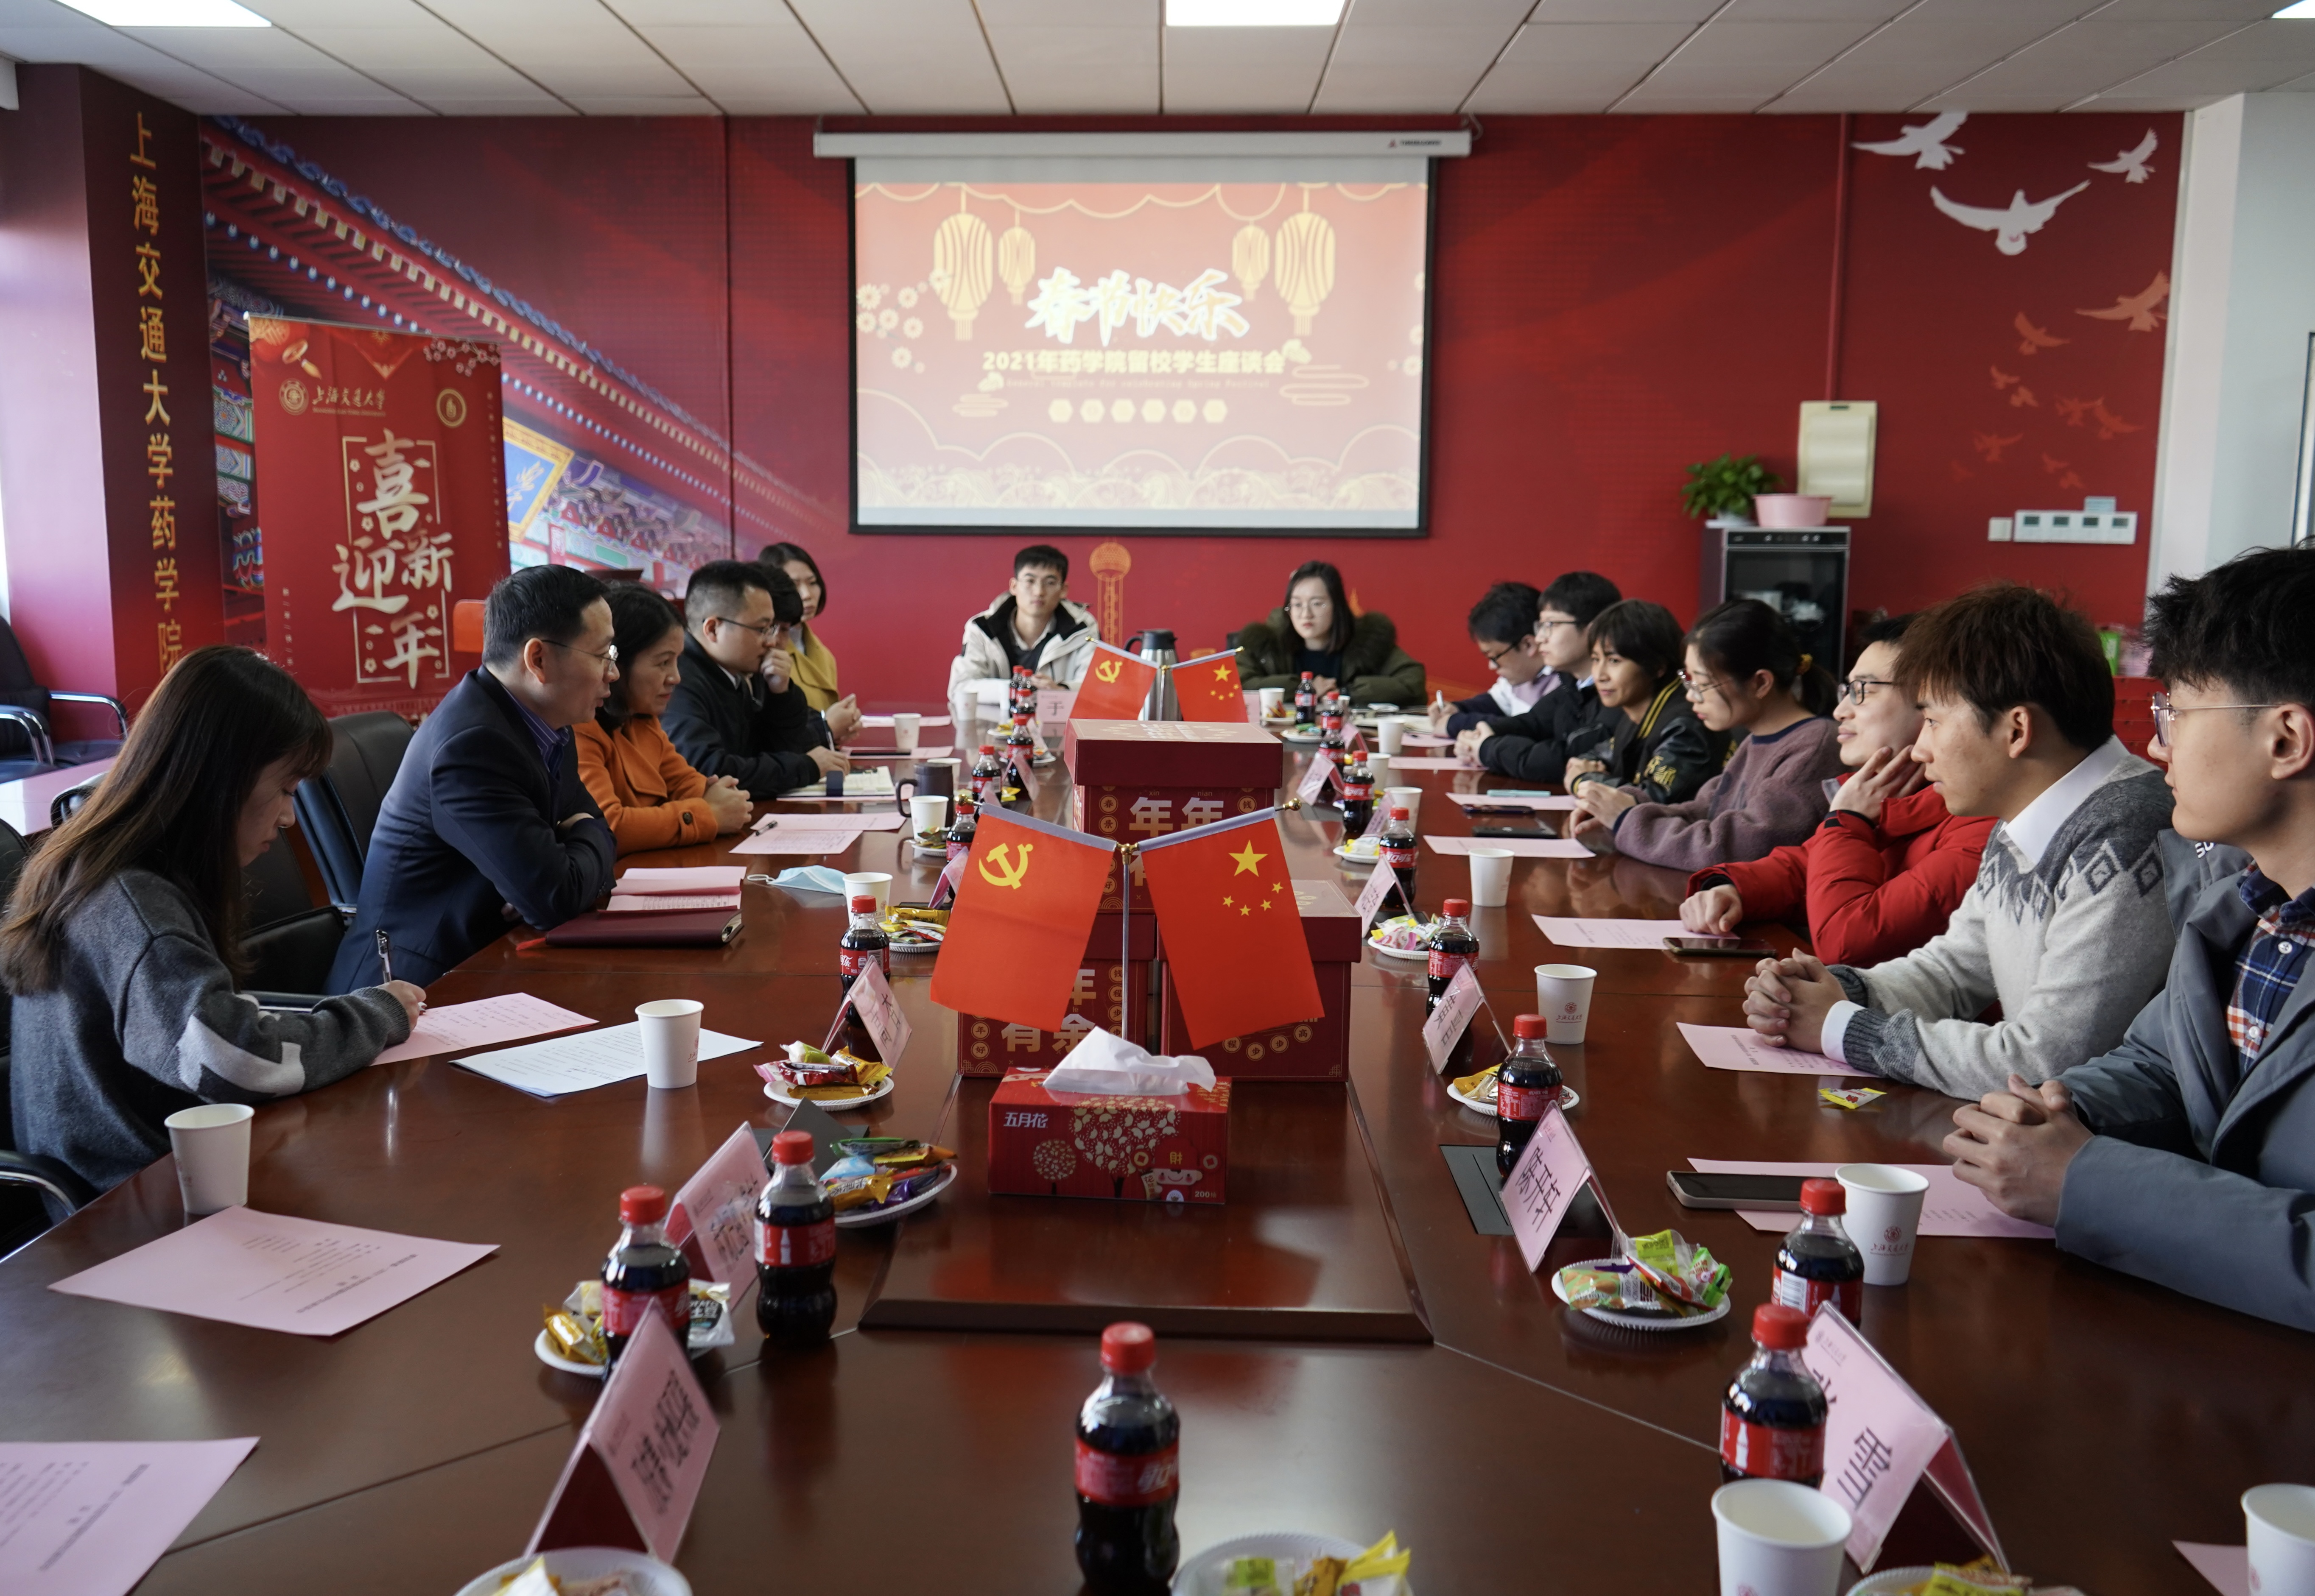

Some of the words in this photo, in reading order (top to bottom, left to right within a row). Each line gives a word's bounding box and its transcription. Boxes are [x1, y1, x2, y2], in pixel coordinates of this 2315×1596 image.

[1024, 266, 1250, 346] 春节快乐
[130, 111, 182, 675] 上海交通大学药学院
[982, 349, 1285, 374] 2021年药学院留校学生座谈会
[1004, 1112, 1048, 1128] 五月花
[1515, 1144, 1561, 1233] 陈开轩
